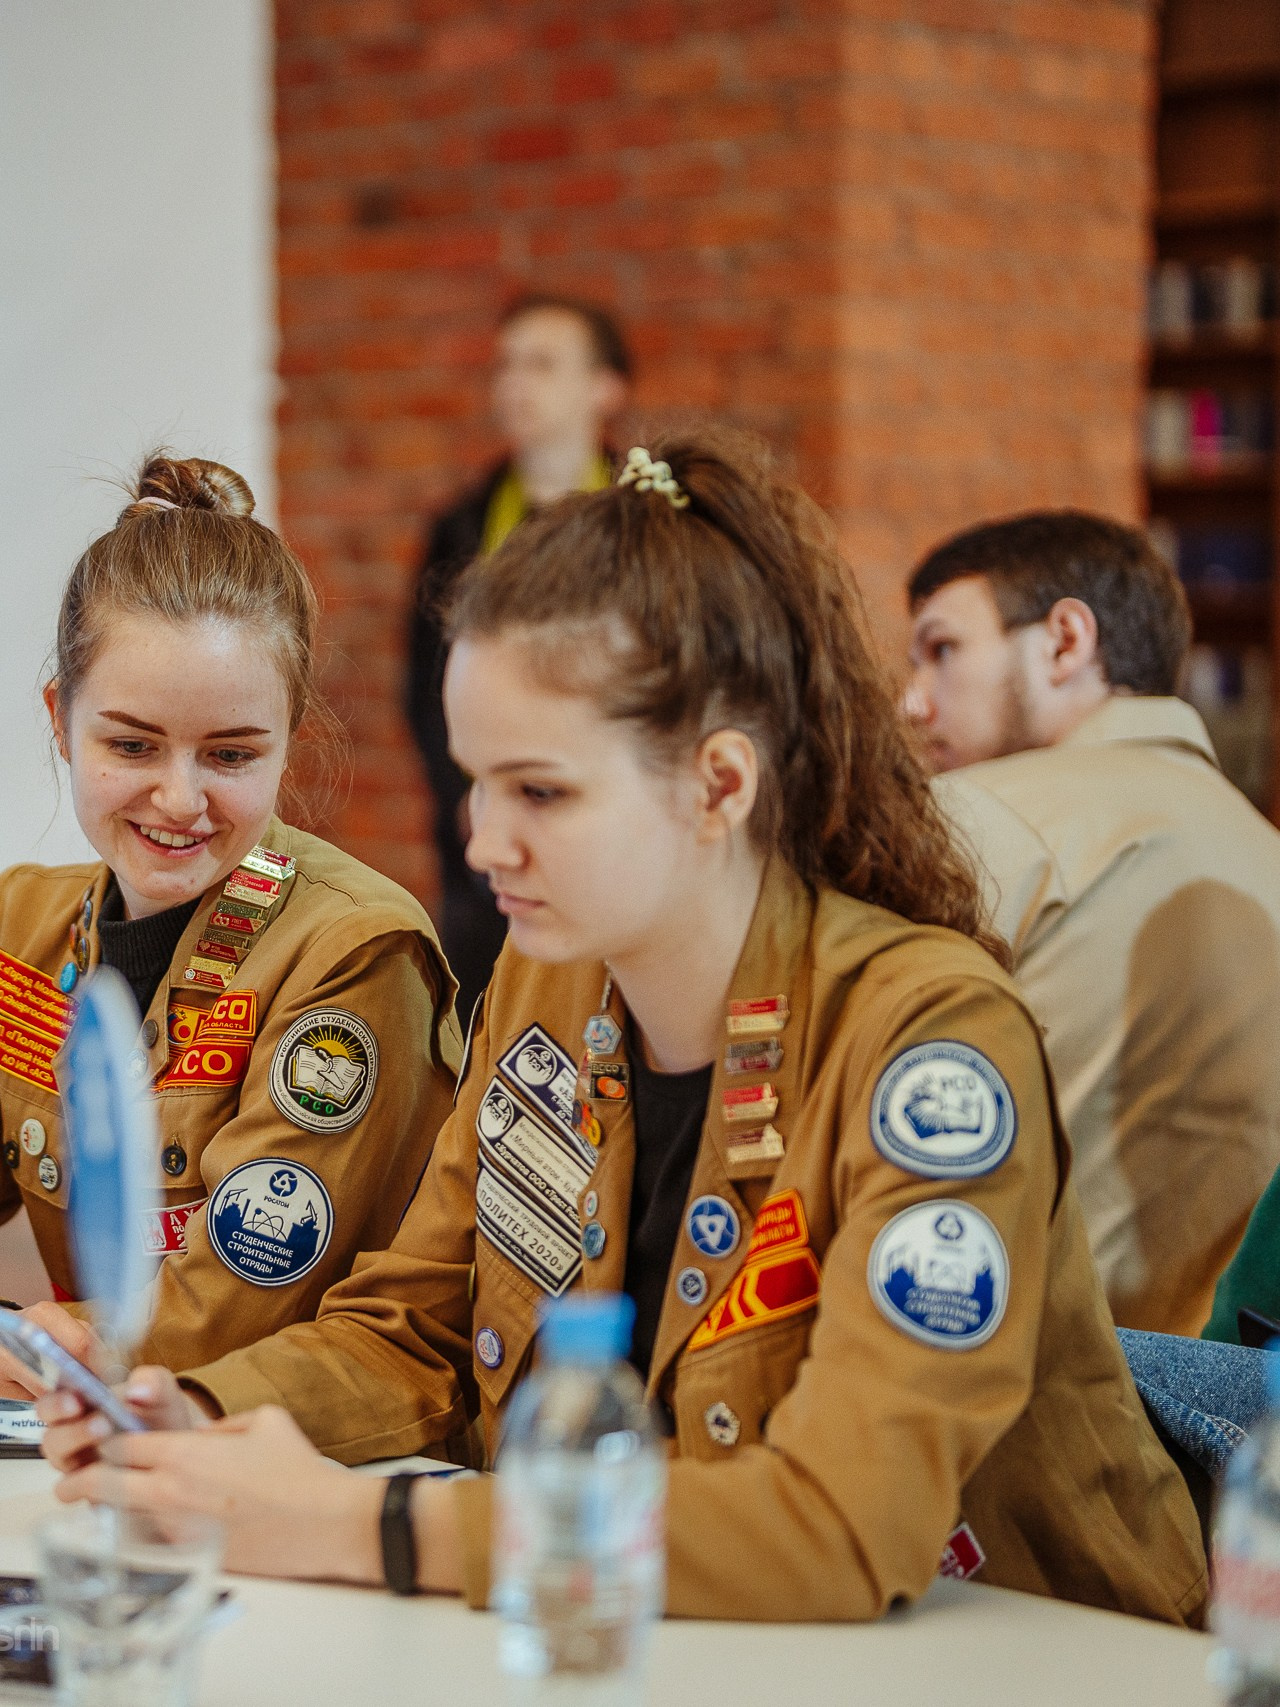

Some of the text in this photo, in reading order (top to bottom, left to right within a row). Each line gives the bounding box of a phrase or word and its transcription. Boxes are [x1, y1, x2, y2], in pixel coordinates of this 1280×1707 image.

[213, 999, 248, 1021] СО
[280, 1017, 320, 1058] РОССИЙСКИЕ
[321, 1016, 371, 1051] СТУДЕНЧЕСКИЕ
[174, 1050, 233, 1075] СО
[299, 1095, 334, 1114] РСО
[528, 1172, 547, 1190] ООО
[264, 1195, 290, 1208] РОСАТОМ
[227, 1240, 292, 1269] СТРОИТЕЛЬНЫЕ
[232, 1231, 294, 1258] СТУДЕНЧЕСКИЕ
[528, 1238, 564, 1271] 2020»
[239, 1256, 273, 1274] ОТРЯДЫ
